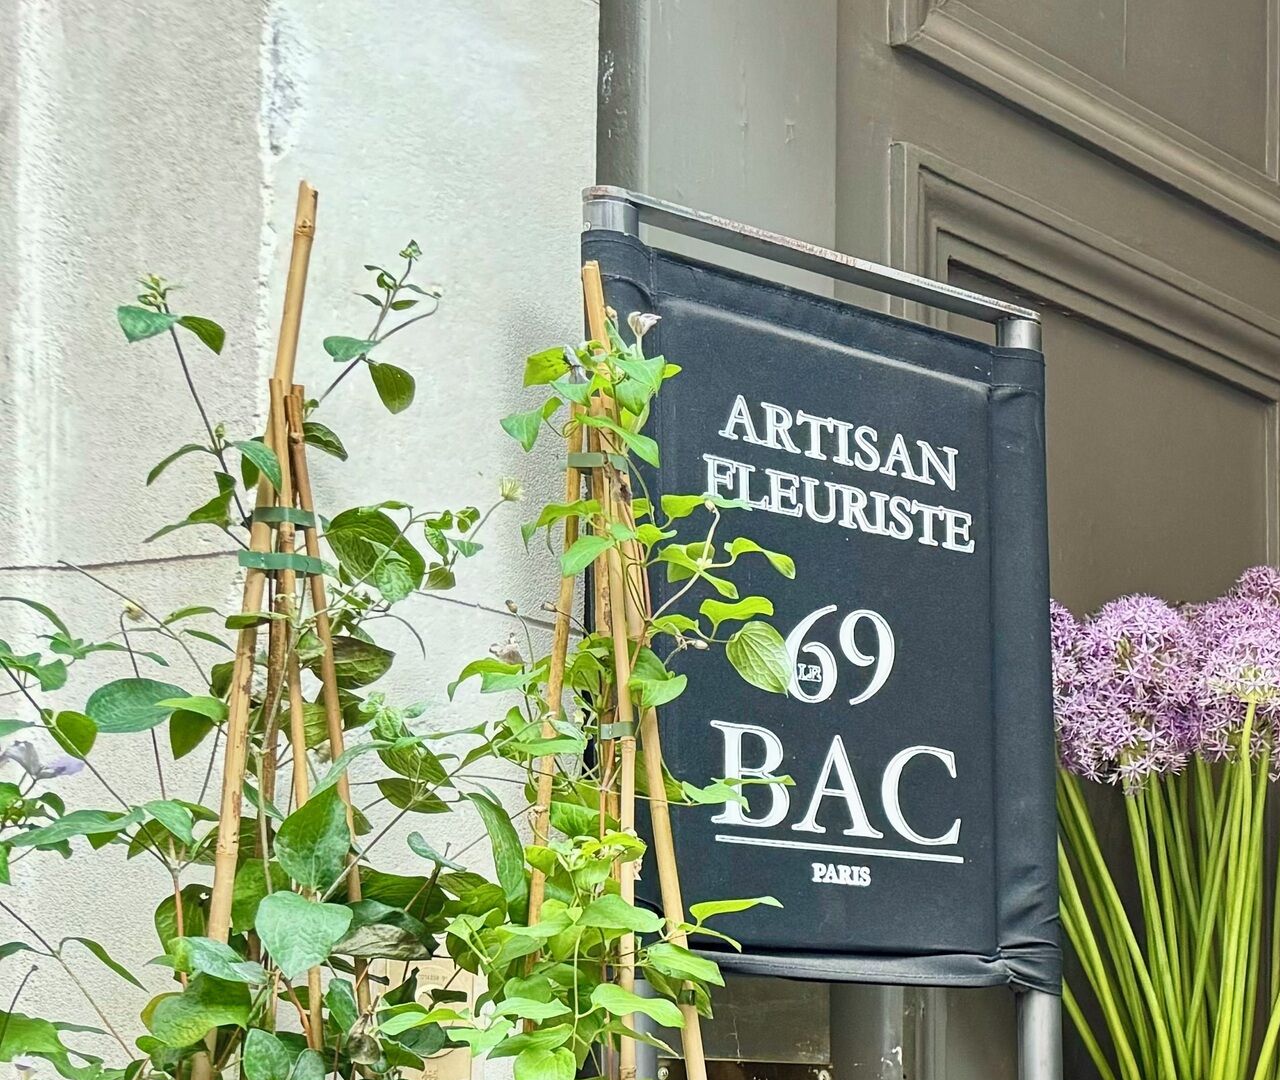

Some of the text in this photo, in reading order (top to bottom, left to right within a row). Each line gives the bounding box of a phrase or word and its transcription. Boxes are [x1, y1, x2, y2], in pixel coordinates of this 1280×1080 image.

[718, 394, 959, 491] ARTISAN
[702, 453, 975, 554] FLEURISTE
[785, 604, 895, 705] 69
[709, 719, 961, 846] BAC
[811, 862, 872, 887] PARIS
